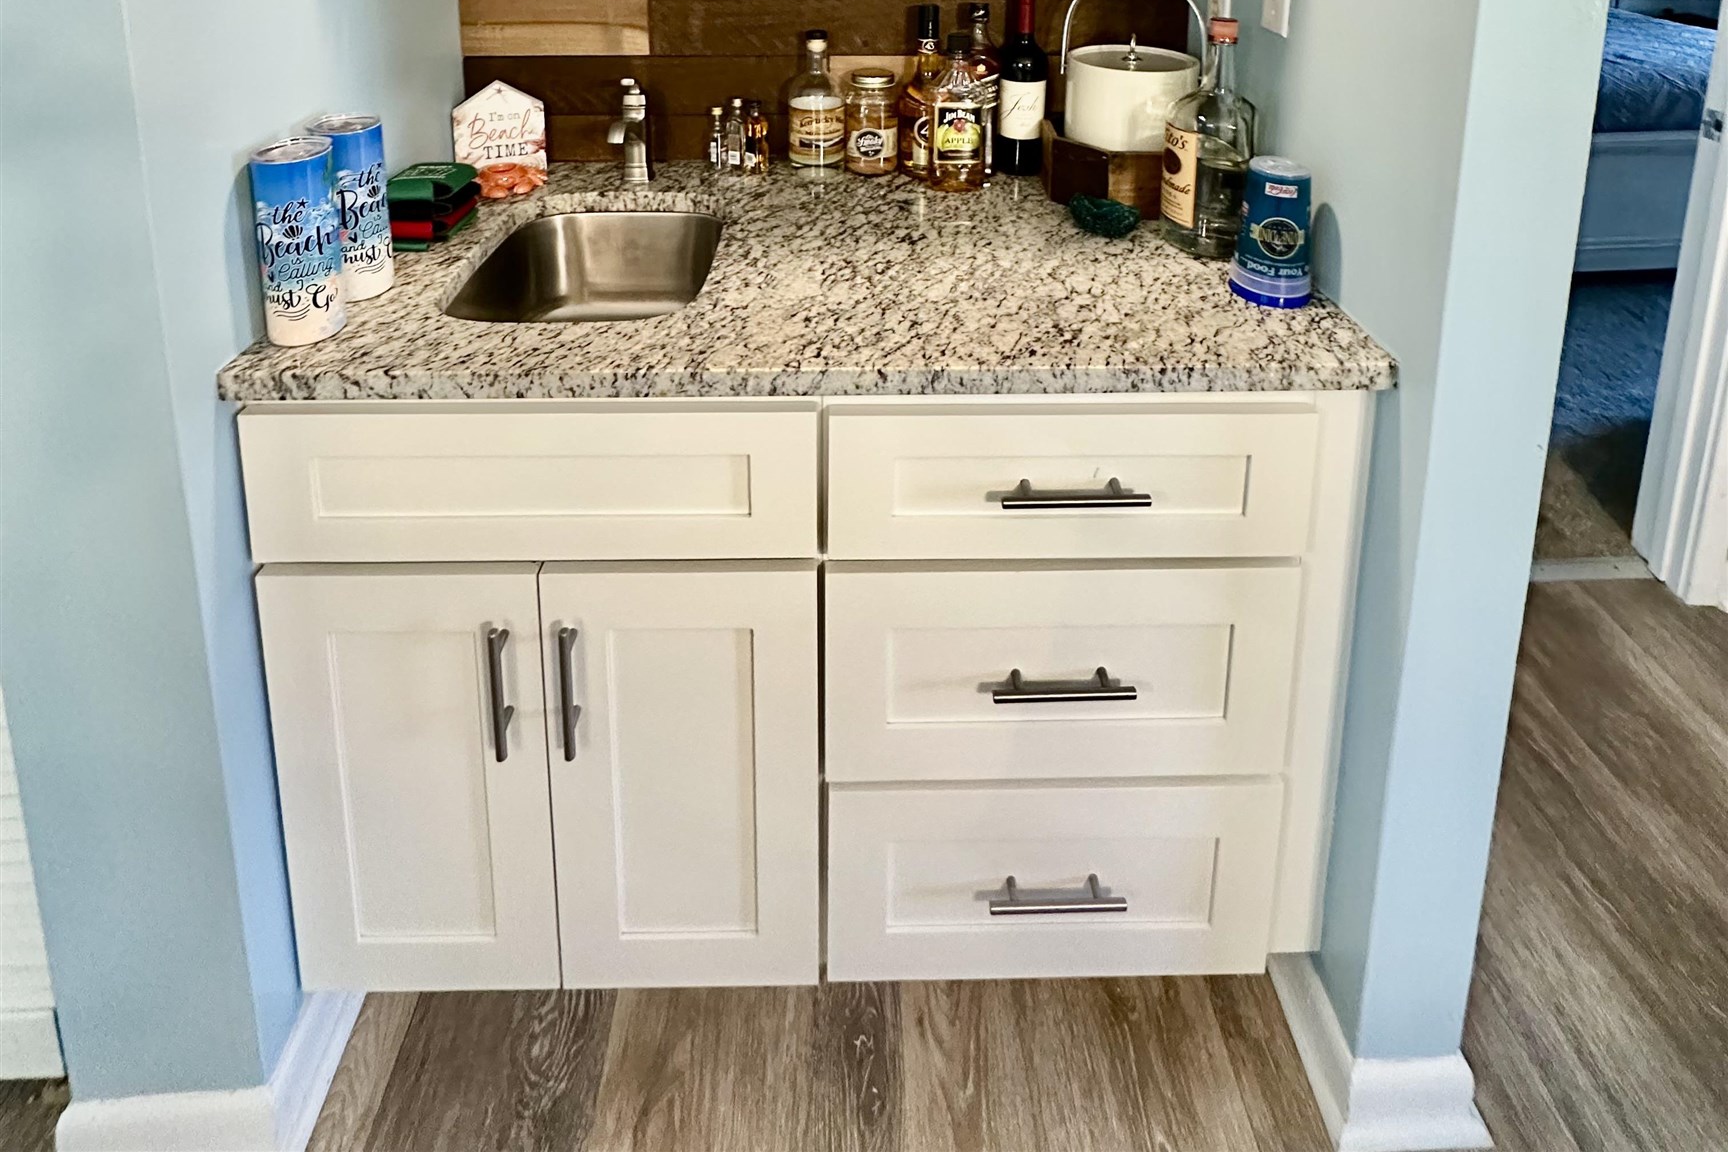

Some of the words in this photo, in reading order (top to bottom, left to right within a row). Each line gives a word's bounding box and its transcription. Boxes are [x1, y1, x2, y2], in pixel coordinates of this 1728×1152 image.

[489, 112, 505, 122] I'm
[507, 112, 520, 120] on
[943, 111, 957, 123] JIM
[467, 109, 534, 150] Beach
[483, 142, 529, 159] TIME
[357, 163, 380, 188] the
[273, 201, 303, 225] the
[336, 189, 387, 231] Bea
[256, 222, 335, 268] Beach
[341, 239, 365, 253] and
[278, 257, 334, 282] Calling
[1278, 267, 1303, 277] Your
[267, 282, 282, 293] nd
[305, 283, 338, 312] Go
